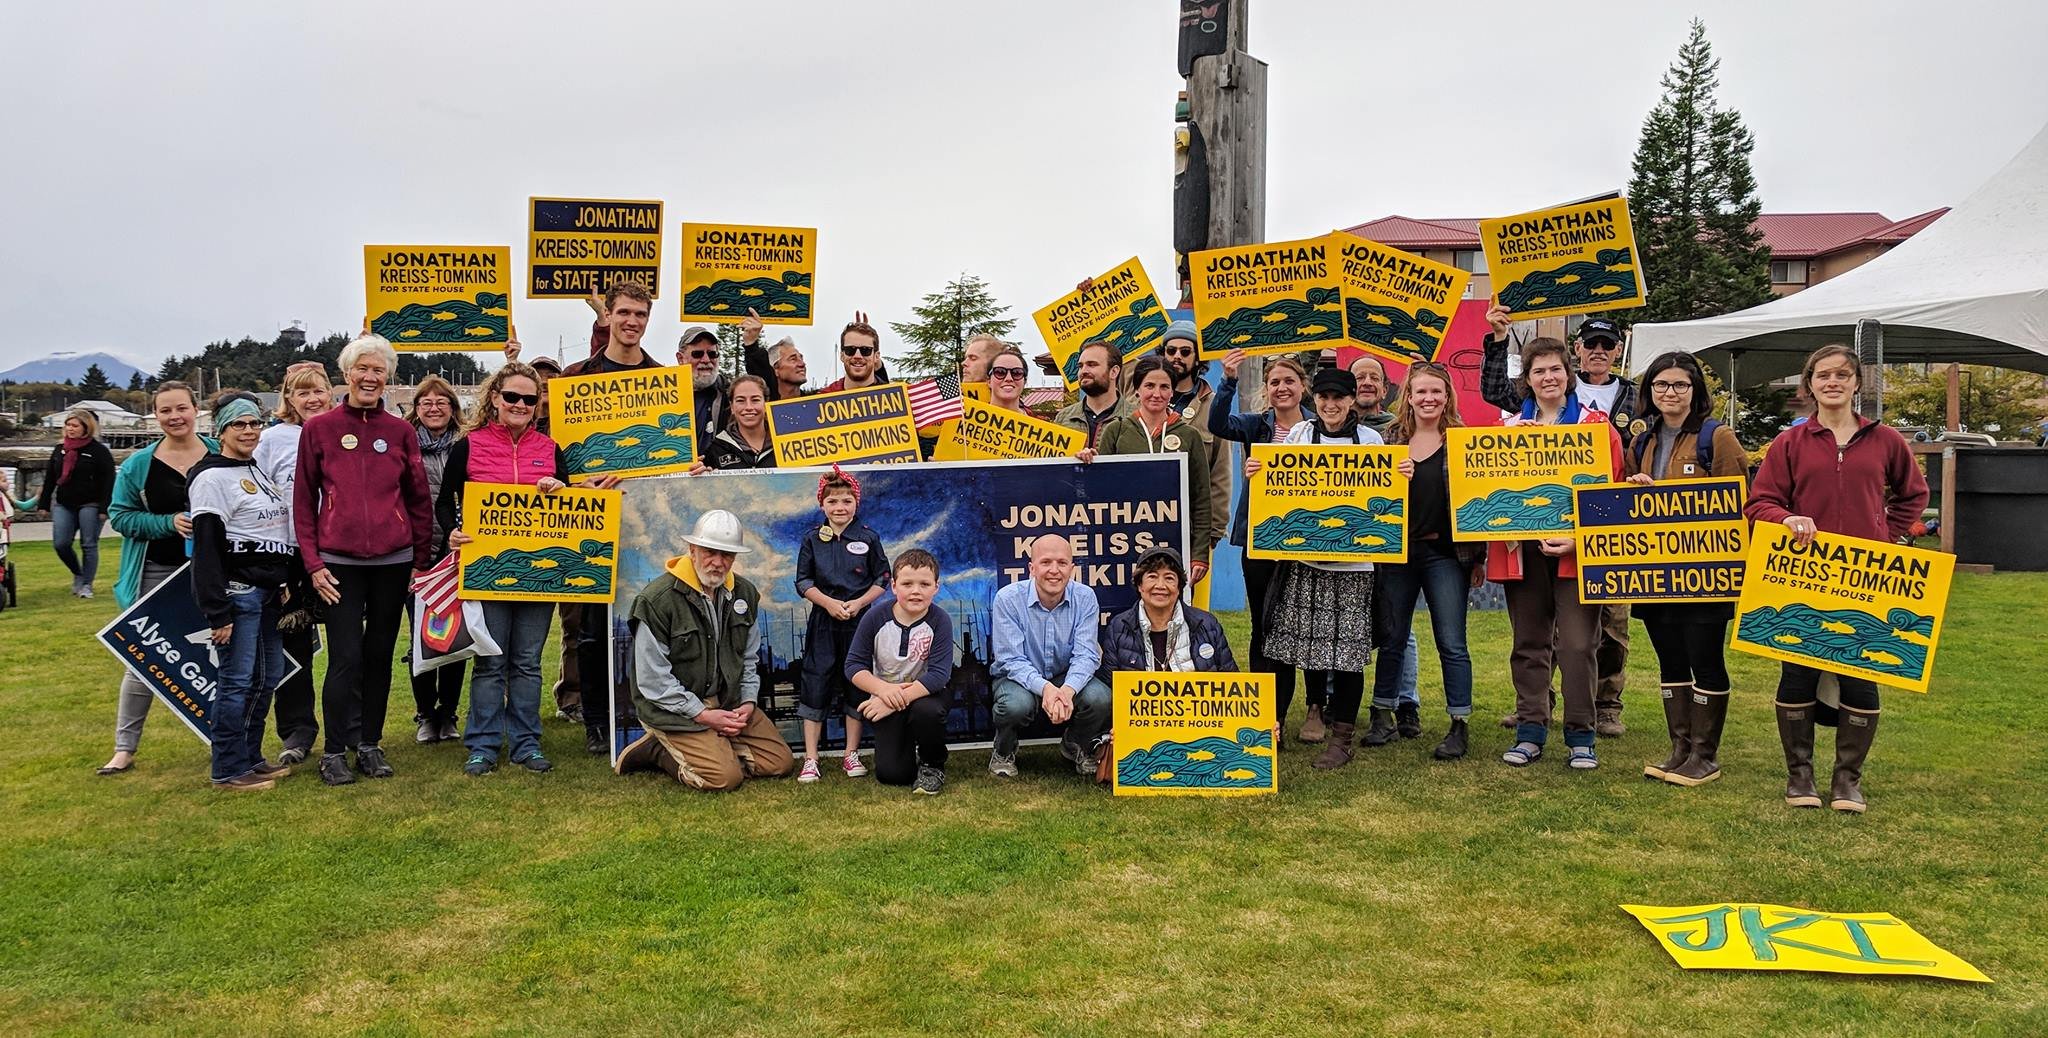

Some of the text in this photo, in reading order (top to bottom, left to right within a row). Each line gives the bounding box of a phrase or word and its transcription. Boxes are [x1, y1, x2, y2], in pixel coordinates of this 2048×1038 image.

[575, 207, 656, 229] JONATHAN
[1497, 207, 1613, 239] JONATHAN
[535, 239, 656, 259] KREISS-TOMKINS
[697, 230, 803, 248] JONATHAN
[1498, 224, 1616, 256] KREISS-TOMKINS
[381, 252, 496, 267] JONATHAN
[696, 246, 803, 263] KREISS-TOMKINS
[1206, 245, 1326, 272] JONATHAN
[1341, 243, 1453, 289] JONATHAN
[1501, 247, 1584, 265] FOR STATE HOUSE
[380, 268, 497, 284] KREISS-TOMKINS
[743, 263, 773, 271] HOUSE
[1207, 262, 1327, 290] KREISS-TOMKINS
[536, 277, 549, 289] for
[552, 270, 599, 290] STATE
[1208, 284, 1294, 300] FOR STATE HOUSE
[1341, 258, 1448, 305] REISS-TOMKINS
[1350, 279, 1378, 293] STATE
[1378, 288, 1411, 303] HOUSE
[1048, 268, 1133, 322] JONATHAN
[1051, 280, 1140, 335] KREISS-TOMKINS
[1057, 306, 1119, 343] FOR STATE HOUSE
[565, 373, 678, 399] JONATHAN
[565, 390, 679, 415] KREISS-TOMKINS
[816, 391, 904, 424] JONATHAN
[565, 410, 647, 425] FOR STATE HOUSE
[964, 407, 1071, 450] JONATHAN
[781, 423, 911, 462] KREISS-TOMKINS
[952, 437, 970, 446] FOR
[973, 441, 999, 455] STATE
[1465, 432, 1593, 451] JONATHAN
[1268, 453, 1392, 469] JONATHAN
[1465, 449, 1595, 468] KREISS-TOMKINS
[1266, 471, 1392, 487] KREISS-TOMKINS
[1489, 470, 1519, 478] STATE
[1523, 469, 1558, 477] HOUSE
[258, 508, 279, 520] Alyse
[482, 491, 606, 513] JONATHAN
[1629, 489, 1738, 518] JONATHAN
[480, 510, 605, 531] KREISS-TOMKINS
[1000, 500, 1178, 529] JONATHAN
[478, 528, 569, 539] FOR STATE HOUSE
[1014, 531, 1169, 559] KEISS-
[1583, 529, 1742, 558] KREISS-TOMKINS
[1771, 535, 1931, 579] JONATHAN
[1587, 567, 1743, 595] for STATE HOUSE
[1762, 574, 1875, 603] FOR STATE HOUSE
[1765, 553, 1926, 600] KREISS-TOMKINS
[128, 615, 181, 664] Alyse
[127, 644, 205, 718] U.S. CONGRESS
[1130, 680, 1260, 698] JONATHAN
[1129, 699, 1260, 718] KREISS-TOMKINS
[1153, 720, 1185, 728] STATE
[1188, 720, 1224, 728] HOUSE
